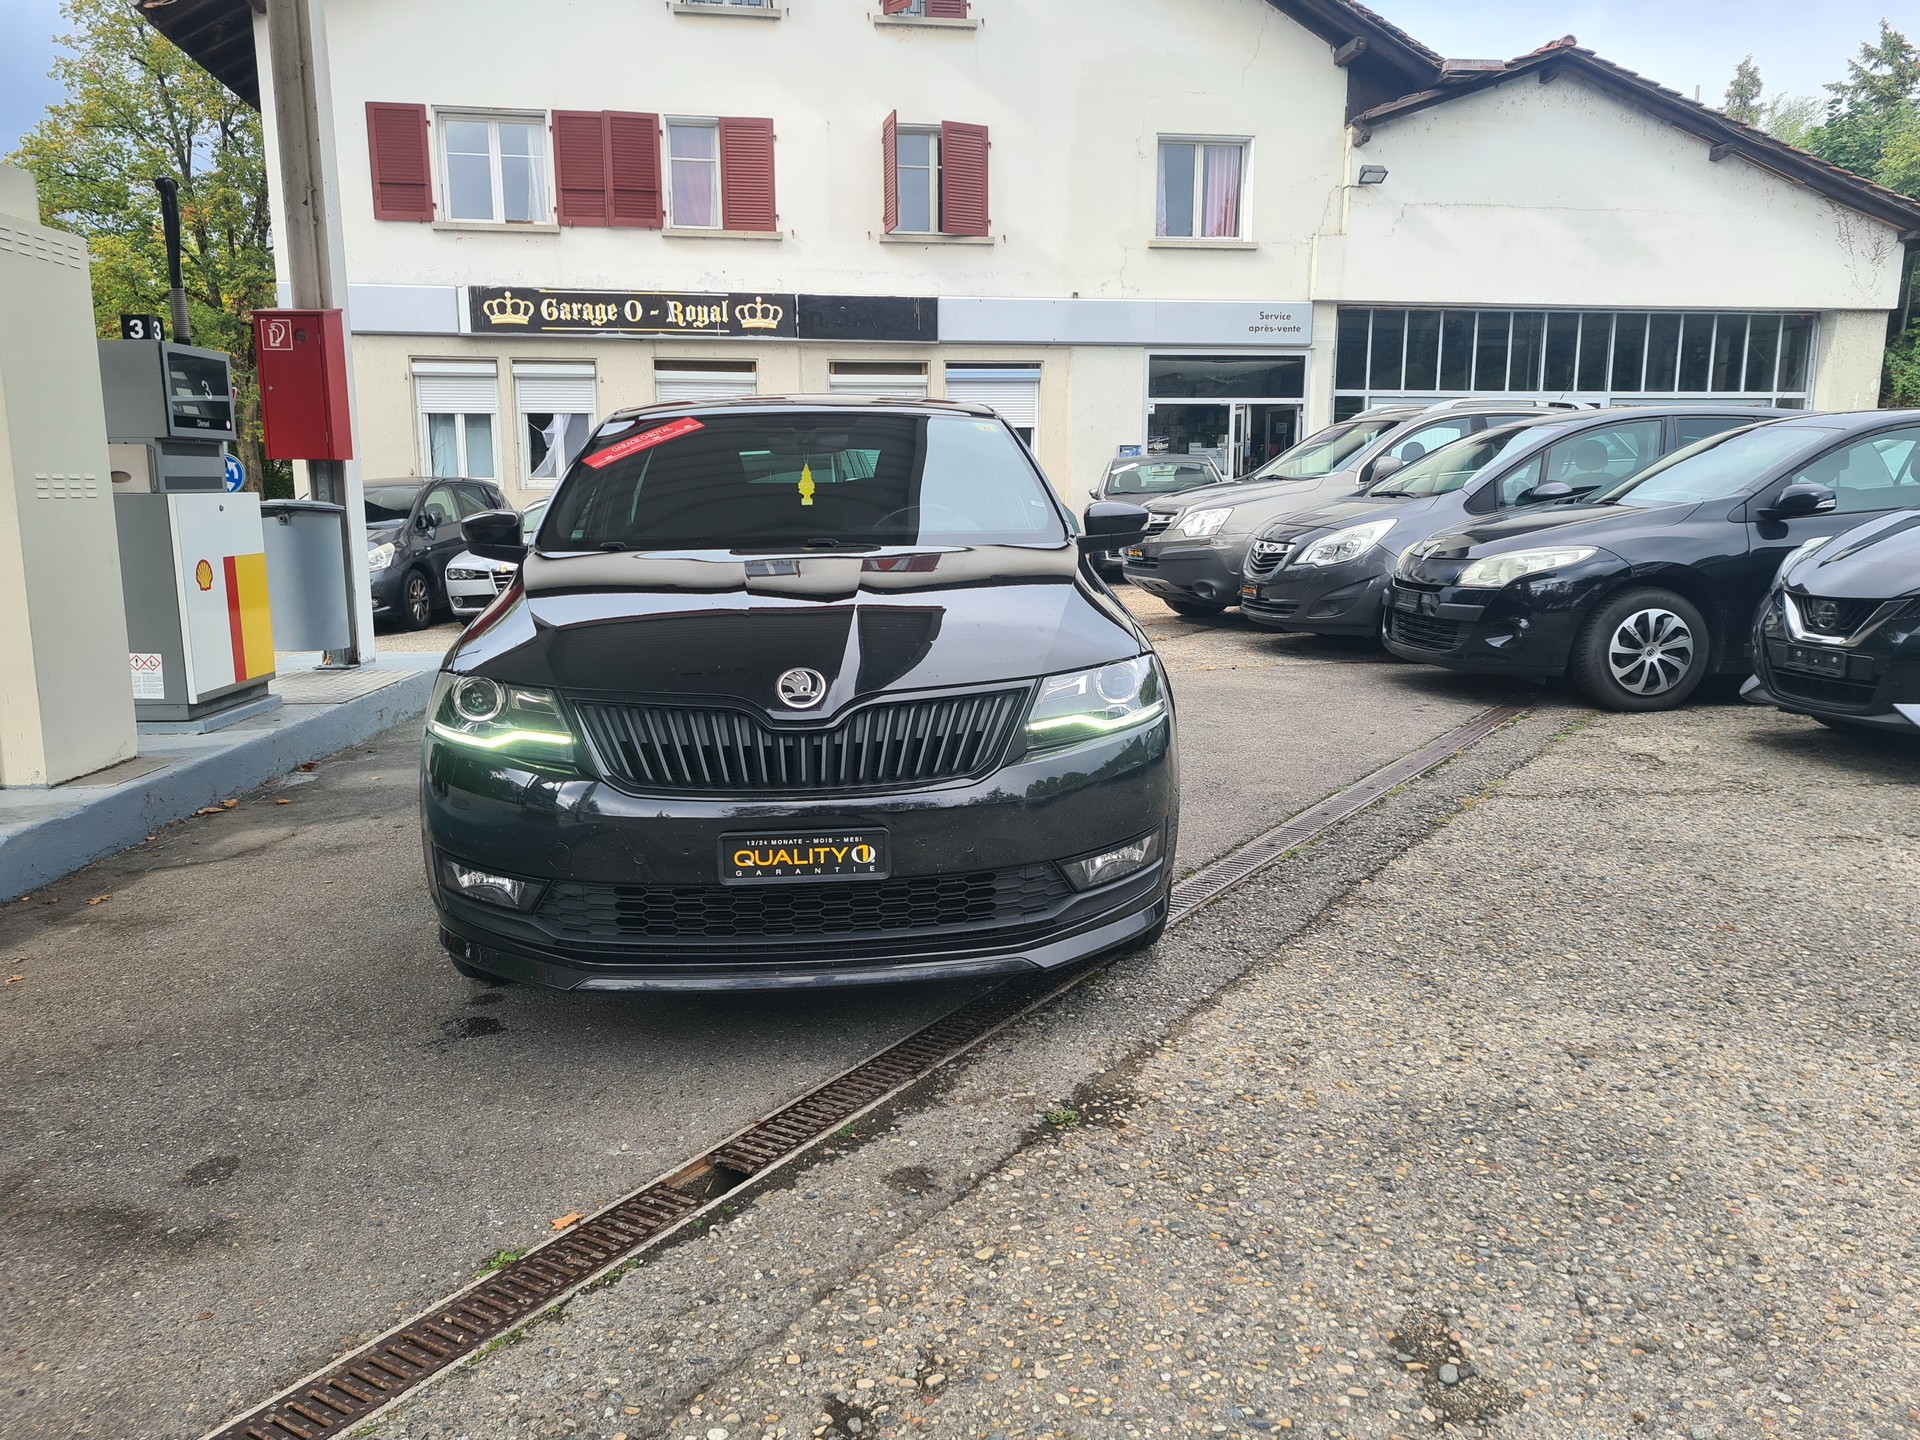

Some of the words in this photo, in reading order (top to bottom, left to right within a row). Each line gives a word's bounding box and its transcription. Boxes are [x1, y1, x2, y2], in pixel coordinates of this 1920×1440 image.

[540, 298, 618, 326] Garage
[623, 300, 643, 322] O
[665, 299, 729, 327] Royal
[1259, 311, 1291, 320] Service
[129, 319, 144, 339] 3
[153, 321, 161, 339] 3
[1248, 324, 1301, 333] après-vente
[201, 380, 213, 400] 3
[733, 847, 849, 867] QUALITY
